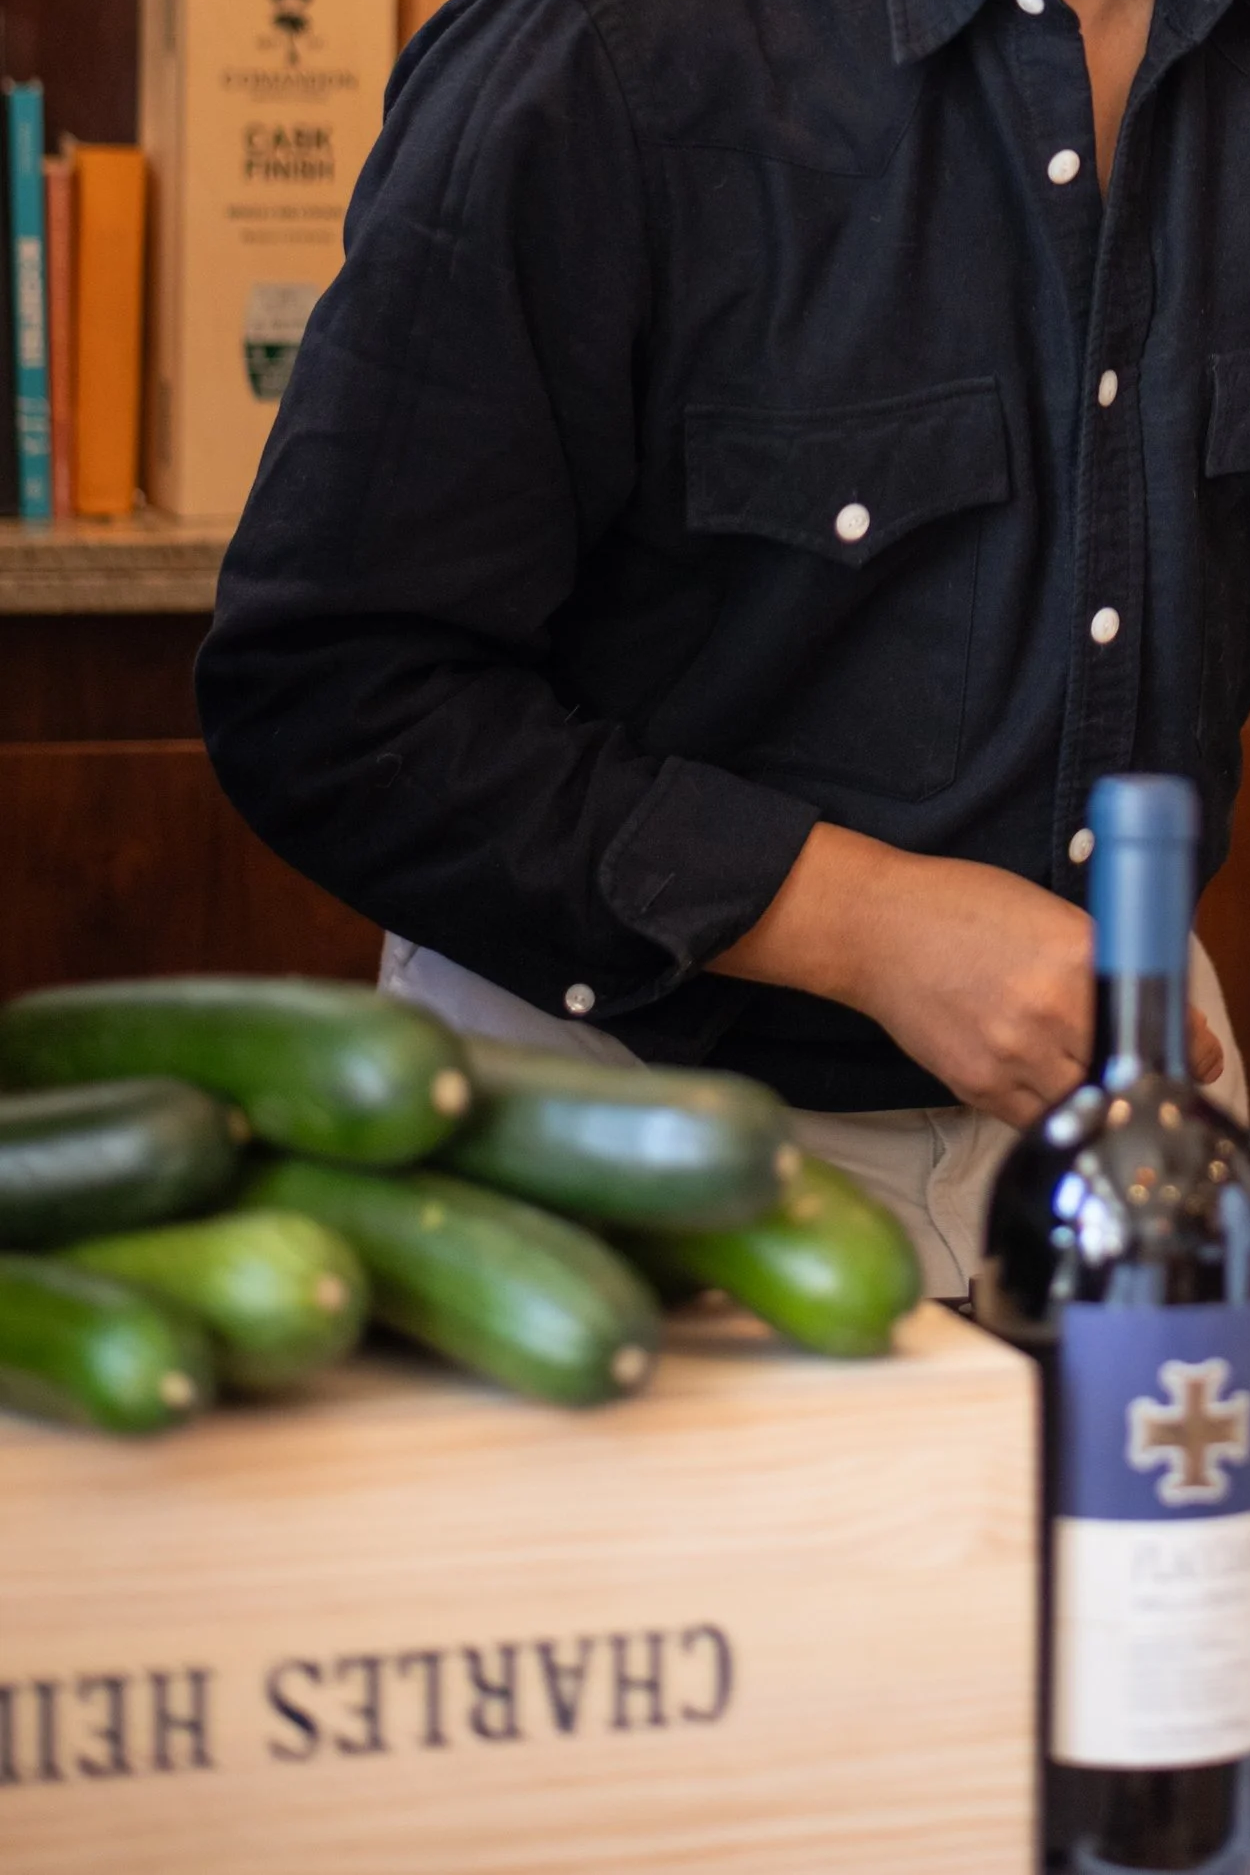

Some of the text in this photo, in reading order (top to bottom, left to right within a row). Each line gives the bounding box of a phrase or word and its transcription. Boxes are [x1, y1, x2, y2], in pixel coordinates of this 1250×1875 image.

[245, 125, 334, 152] CASK
[244, 155, 335, 182] FINISH
[263, 1622, 736, 1762] CHARLES
